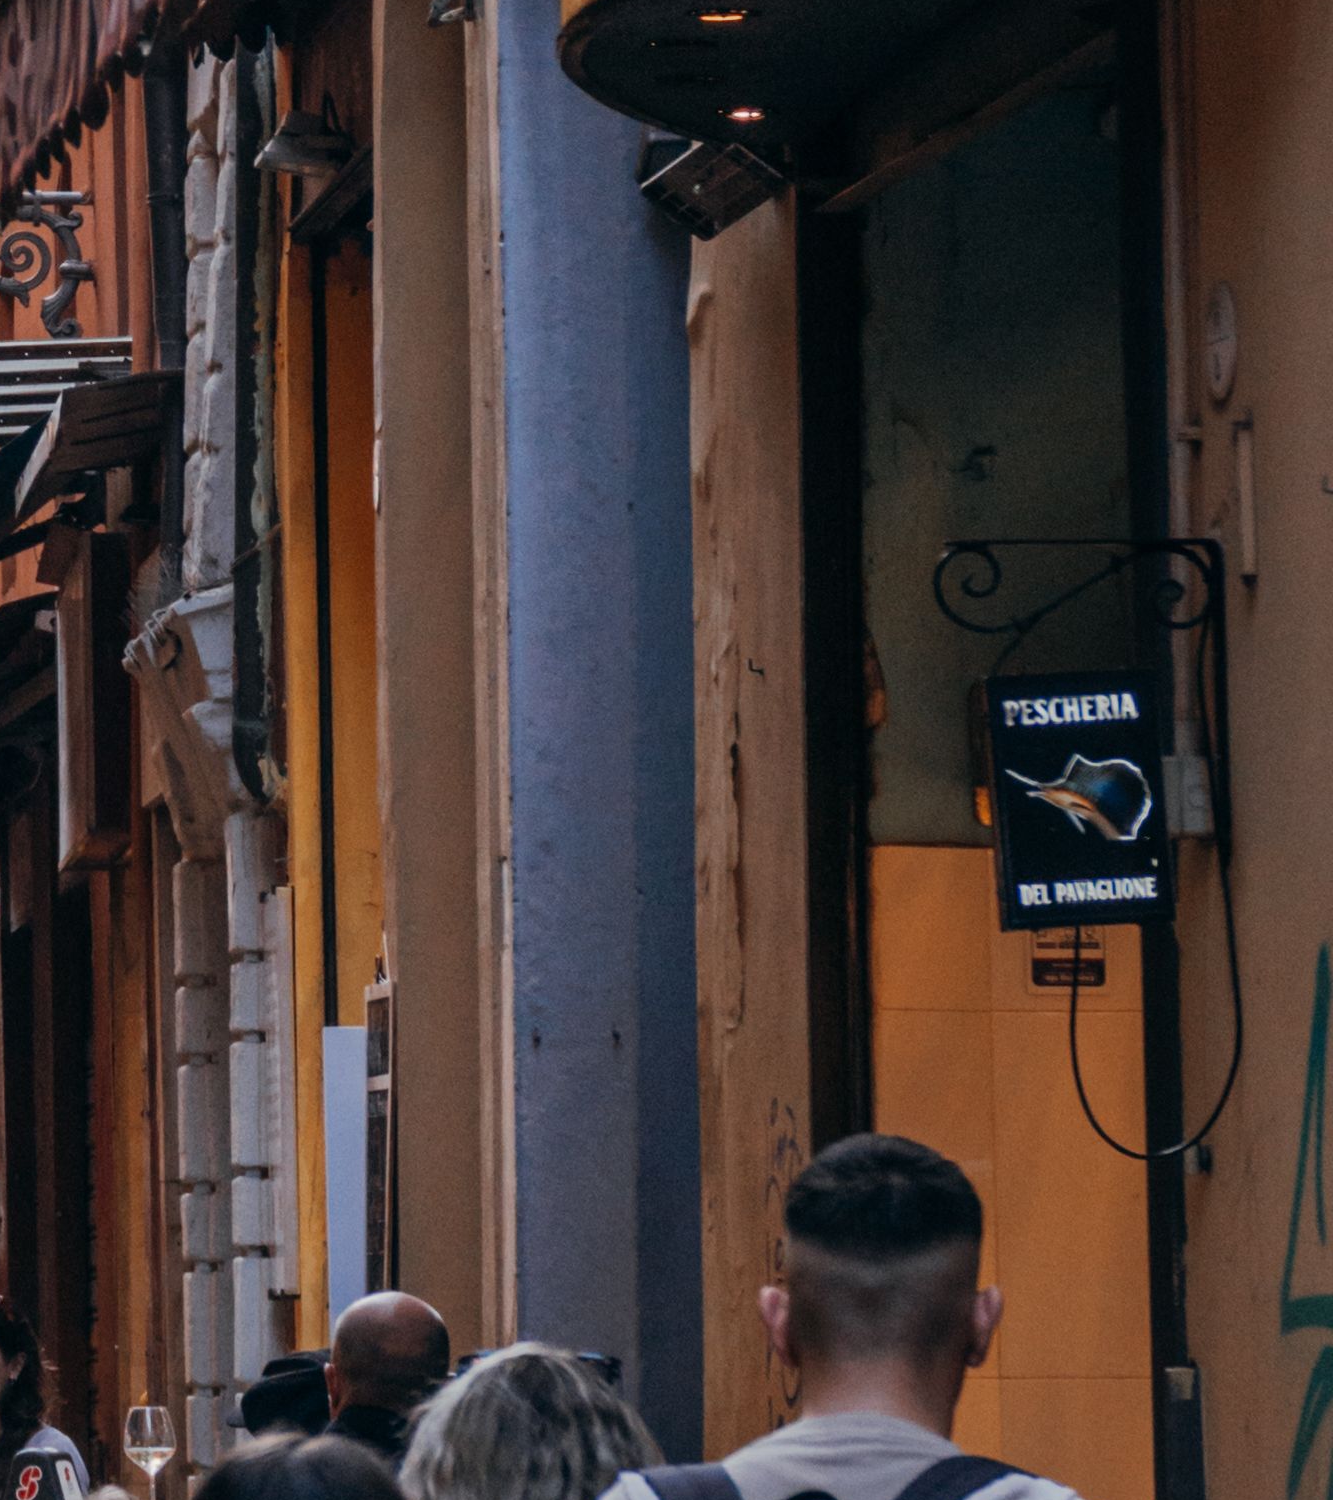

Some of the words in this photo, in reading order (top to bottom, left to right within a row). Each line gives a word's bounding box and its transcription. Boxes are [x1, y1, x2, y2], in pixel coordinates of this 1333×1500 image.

[1002, 692, 1140, 727] PESCHERIA
[1017, 884, 1052, 907] DEL
[1054, 876, 1159, 904] PAVAGLIONE
